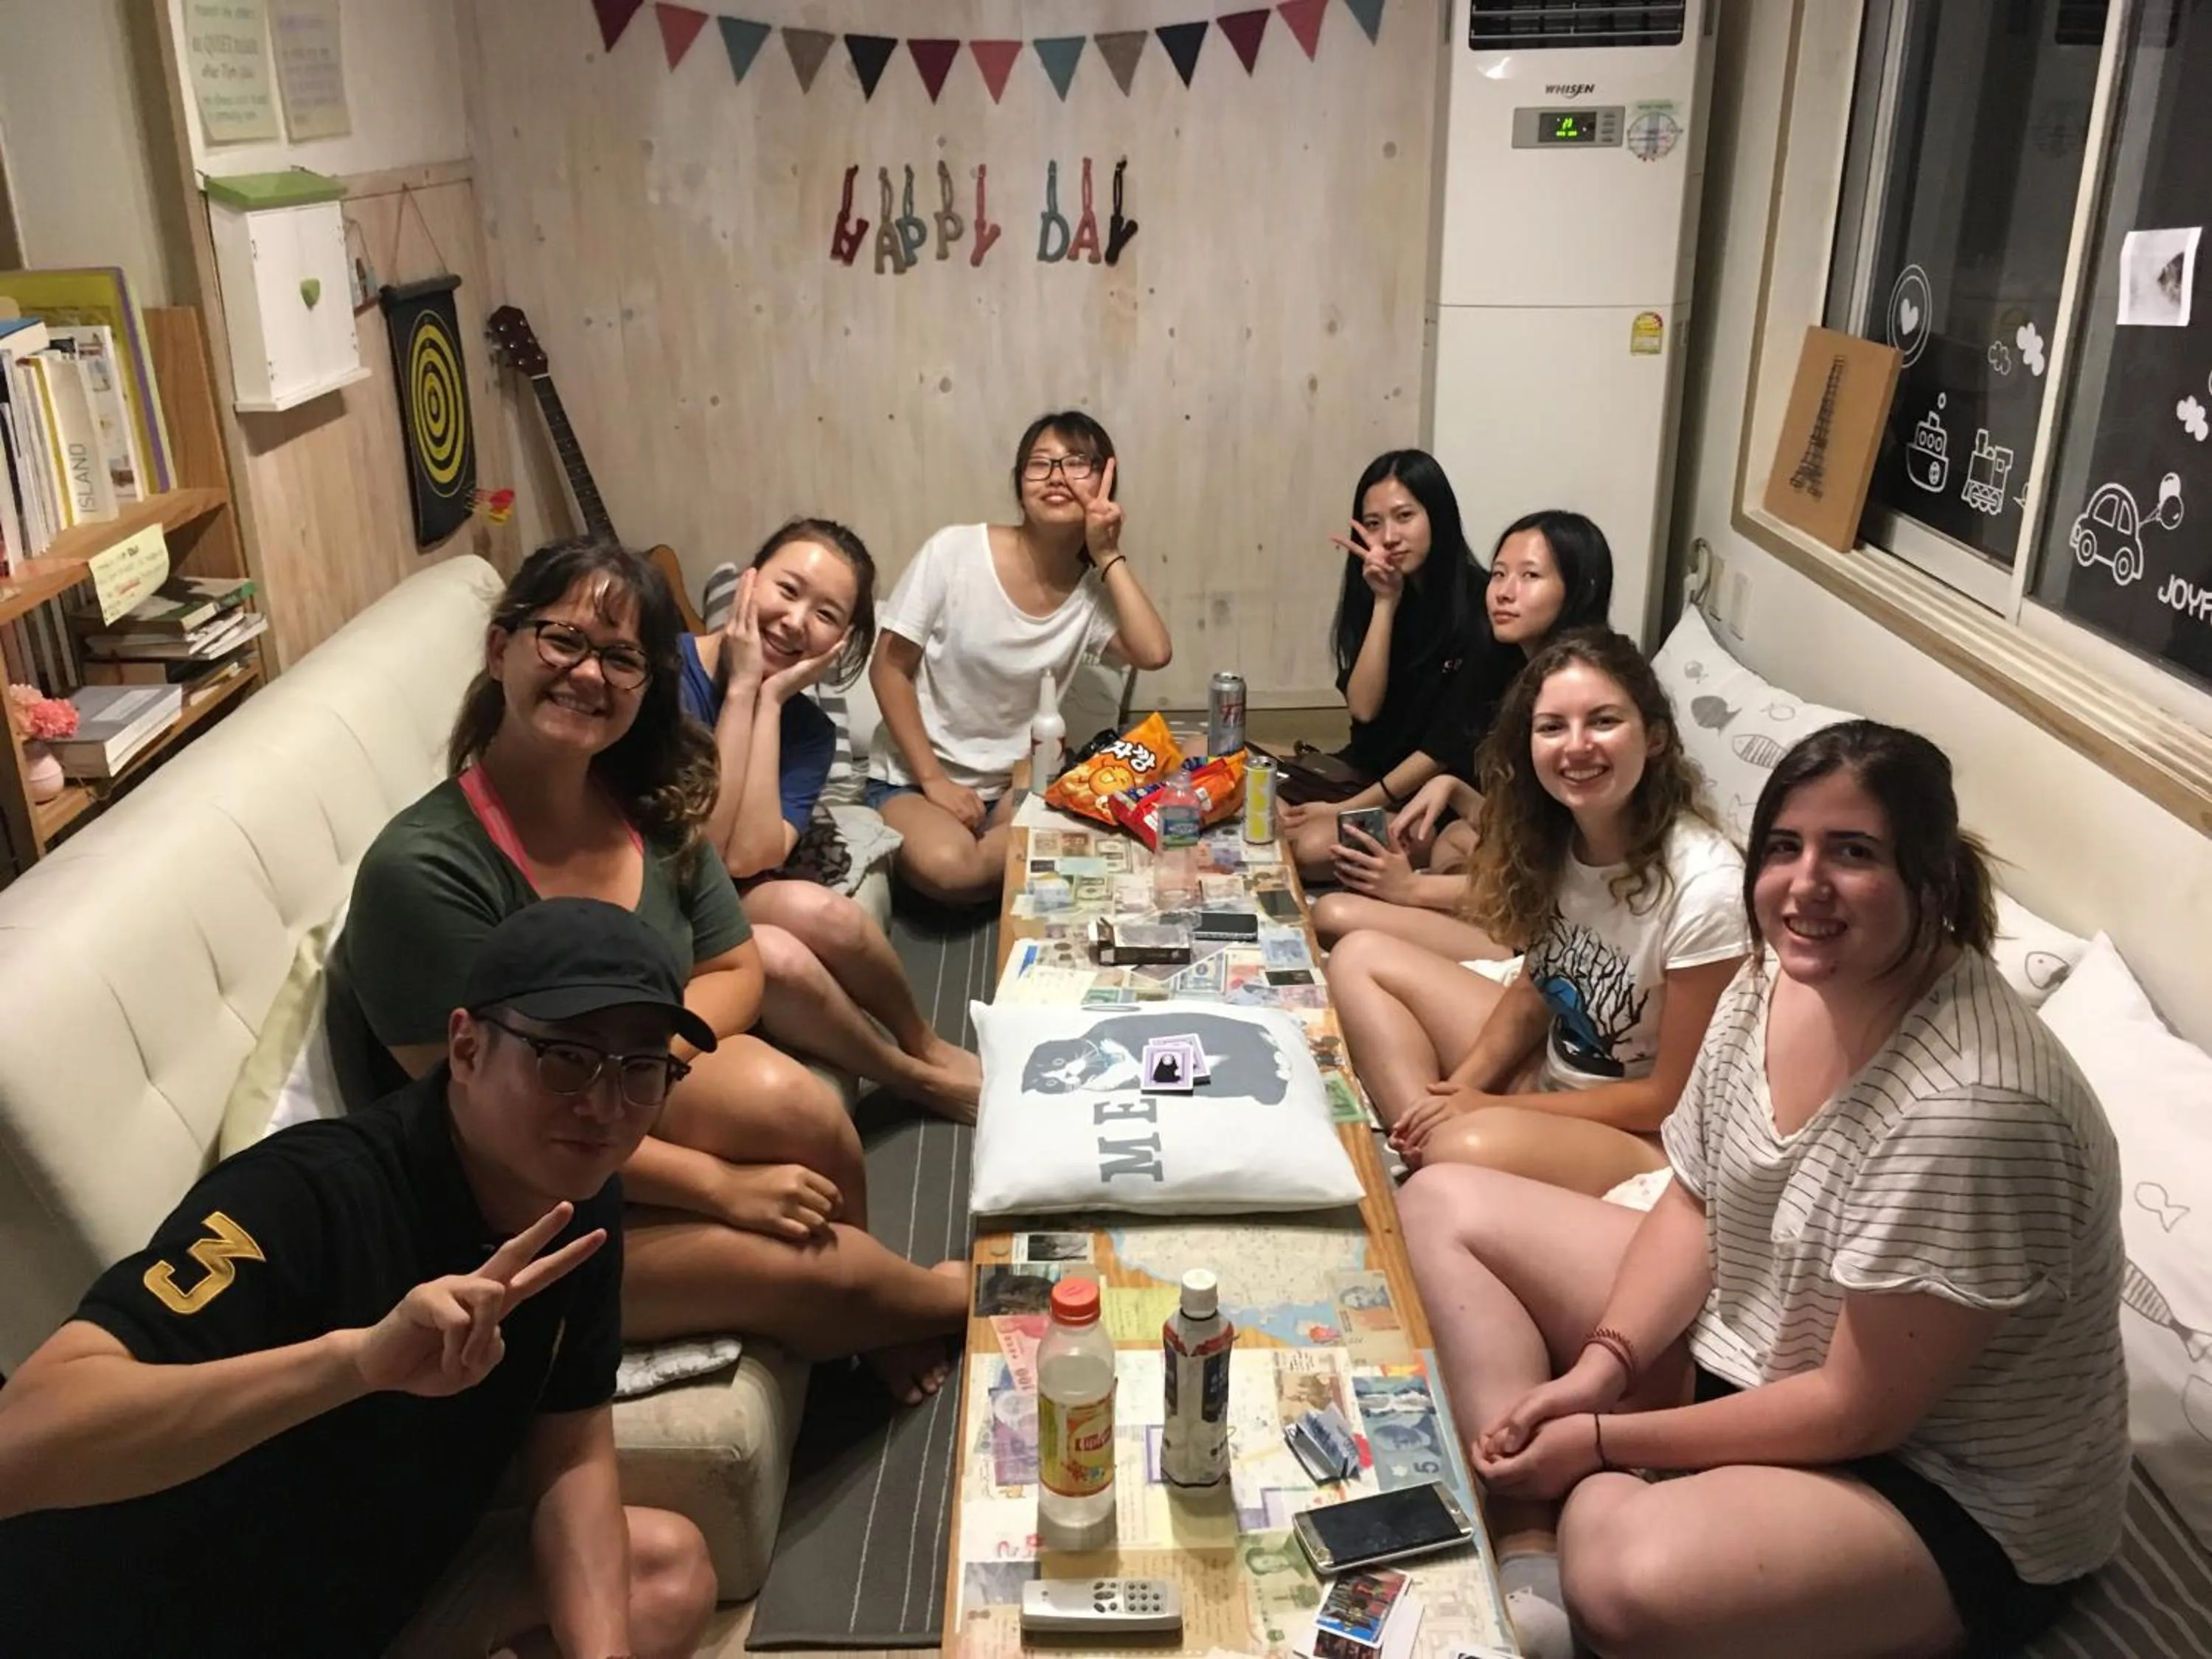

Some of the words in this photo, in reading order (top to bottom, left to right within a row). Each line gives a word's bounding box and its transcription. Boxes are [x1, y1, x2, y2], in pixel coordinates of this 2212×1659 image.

[1545, 83, 1596, 97] WHISEN
[830, 211, 1001, 274] HAPPY
[1037, 209, 1138, 267] DAY
[69, 443, 97, 513] ISLAND
[2157, 574, 2212, 627] JOYF
[1093, 740, 1156, 773] 자깡
